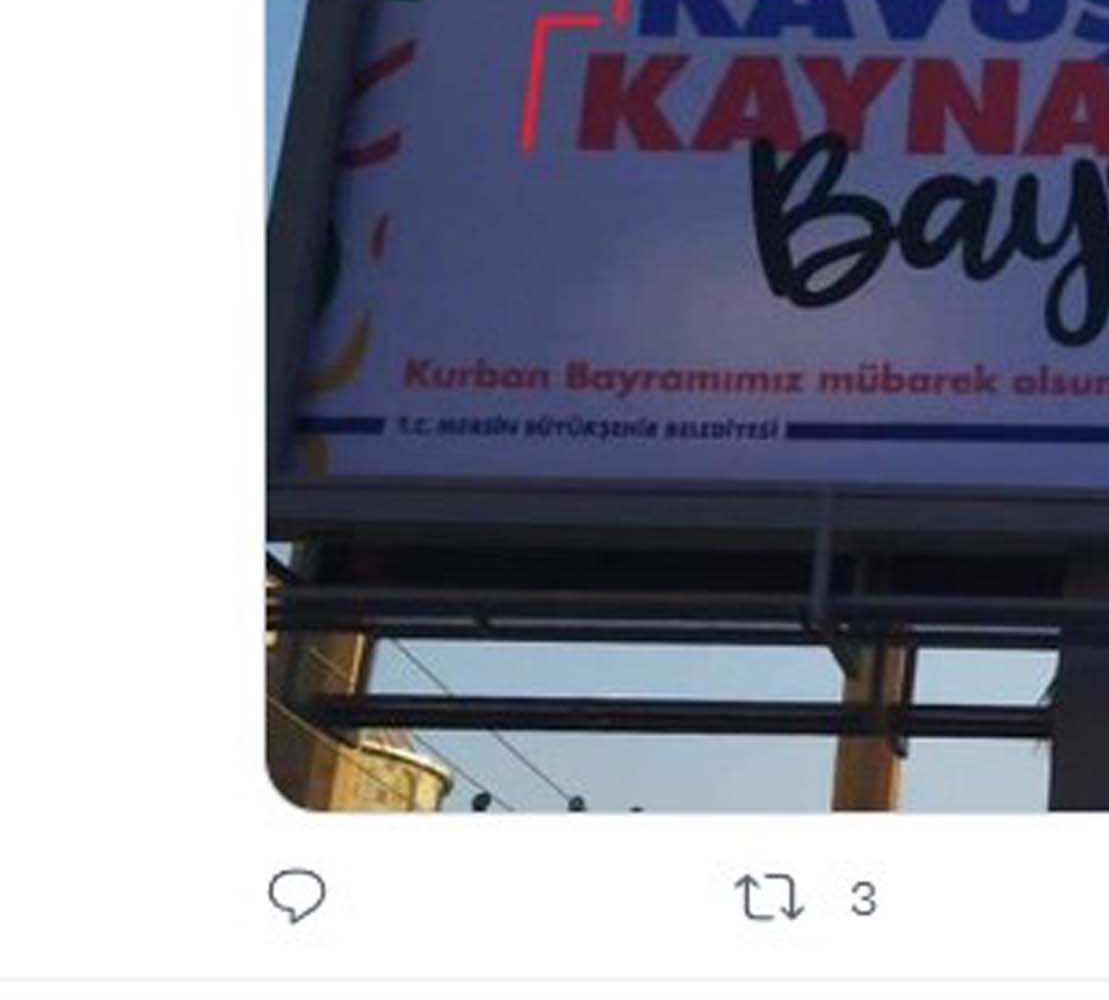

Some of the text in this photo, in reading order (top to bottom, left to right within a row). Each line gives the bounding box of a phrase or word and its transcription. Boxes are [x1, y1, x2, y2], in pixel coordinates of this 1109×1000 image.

[404, 358, 551, 390] Kurban
[565, 359, 805, 400] Bayramımız
[819, 361, 999, 396] mübarek
[852, 881, 876, 917] 3
